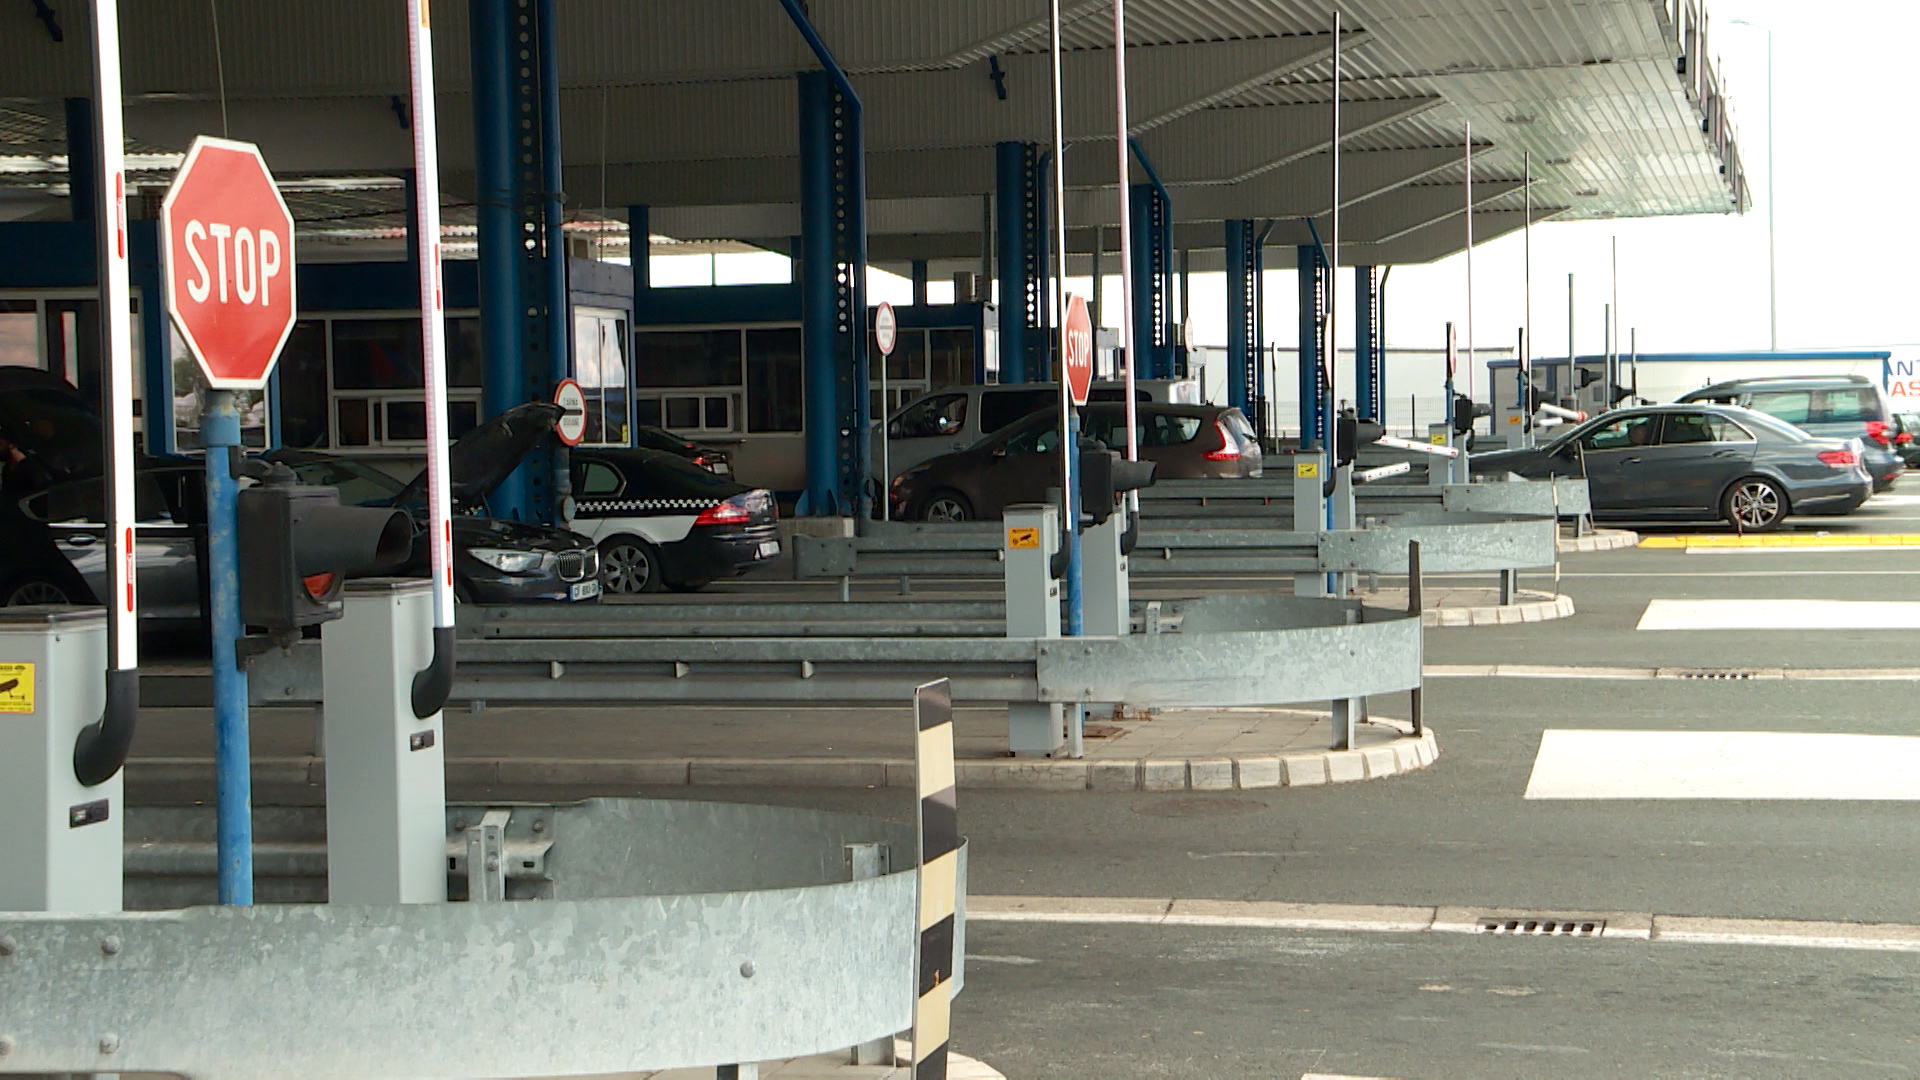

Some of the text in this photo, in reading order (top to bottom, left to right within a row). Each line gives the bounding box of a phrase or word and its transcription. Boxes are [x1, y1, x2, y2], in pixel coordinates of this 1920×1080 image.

[185, 220, 281, 306] STOP
[1068, 330, 1089, 368] STOP
[1889, 380, 1920, 397] AS
